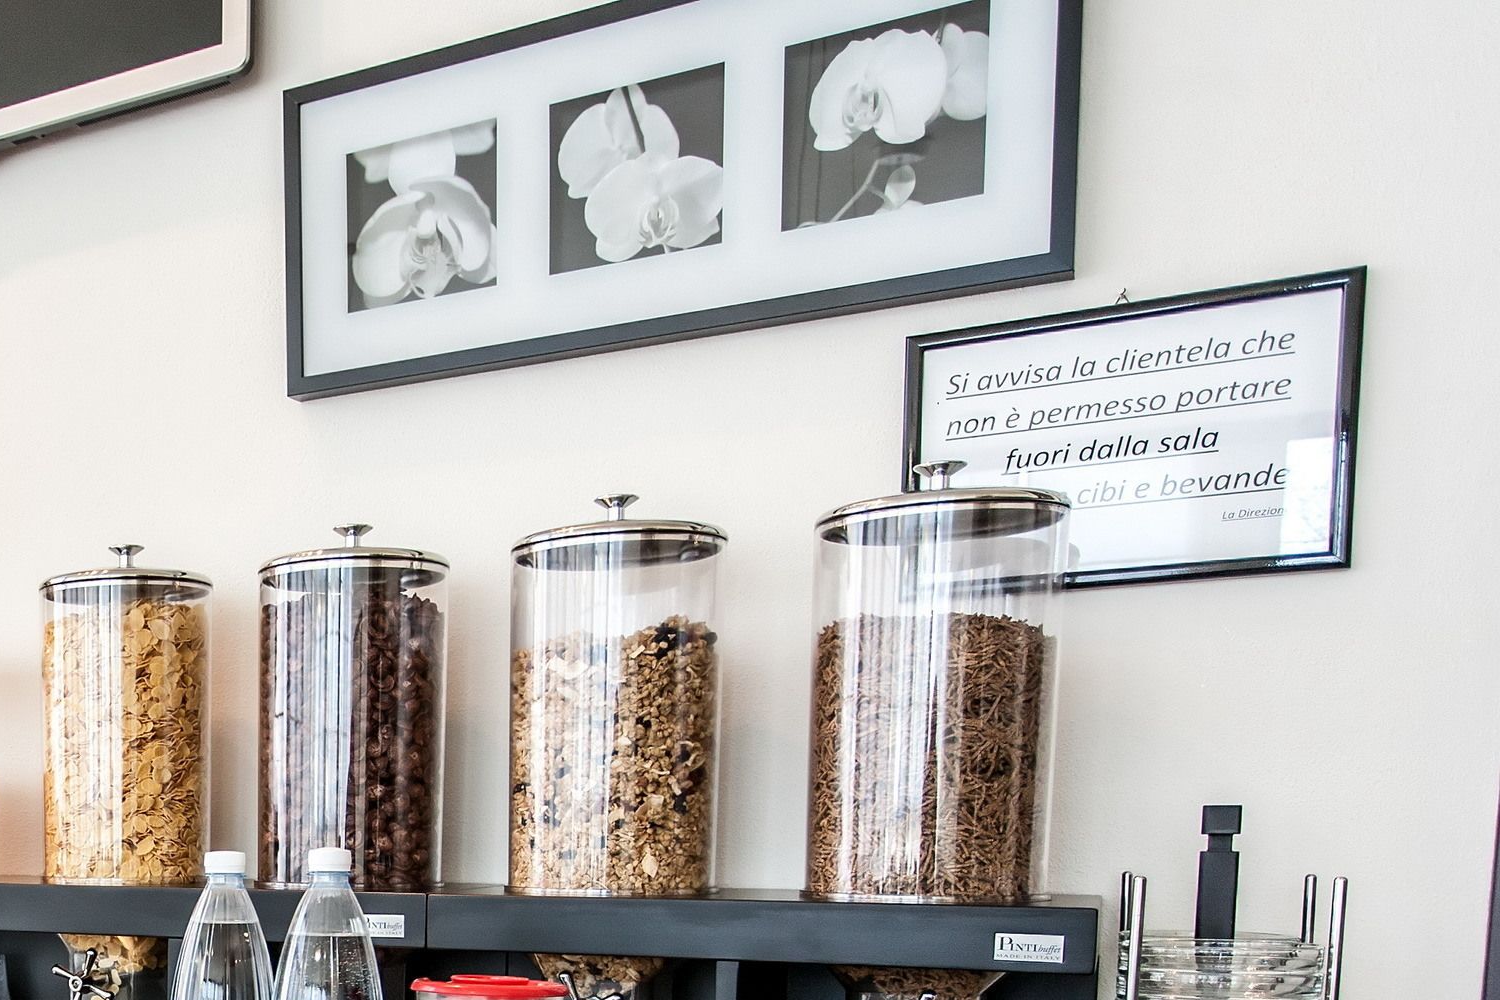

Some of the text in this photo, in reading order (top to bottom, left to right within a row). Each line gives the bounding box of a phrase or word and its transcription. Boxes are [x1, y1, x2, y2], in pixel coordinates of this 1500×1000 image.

[946, 330, 1296, 396] Si avvisa la clientela che
[946, 376, 1292, 438] non è permesso portare
[1003, 427, 1220, 474] fuori dalla sala
[1077, 462, 1287, 505] cibi e bevande
[1222, 506, 1285, 520] La Direzion
